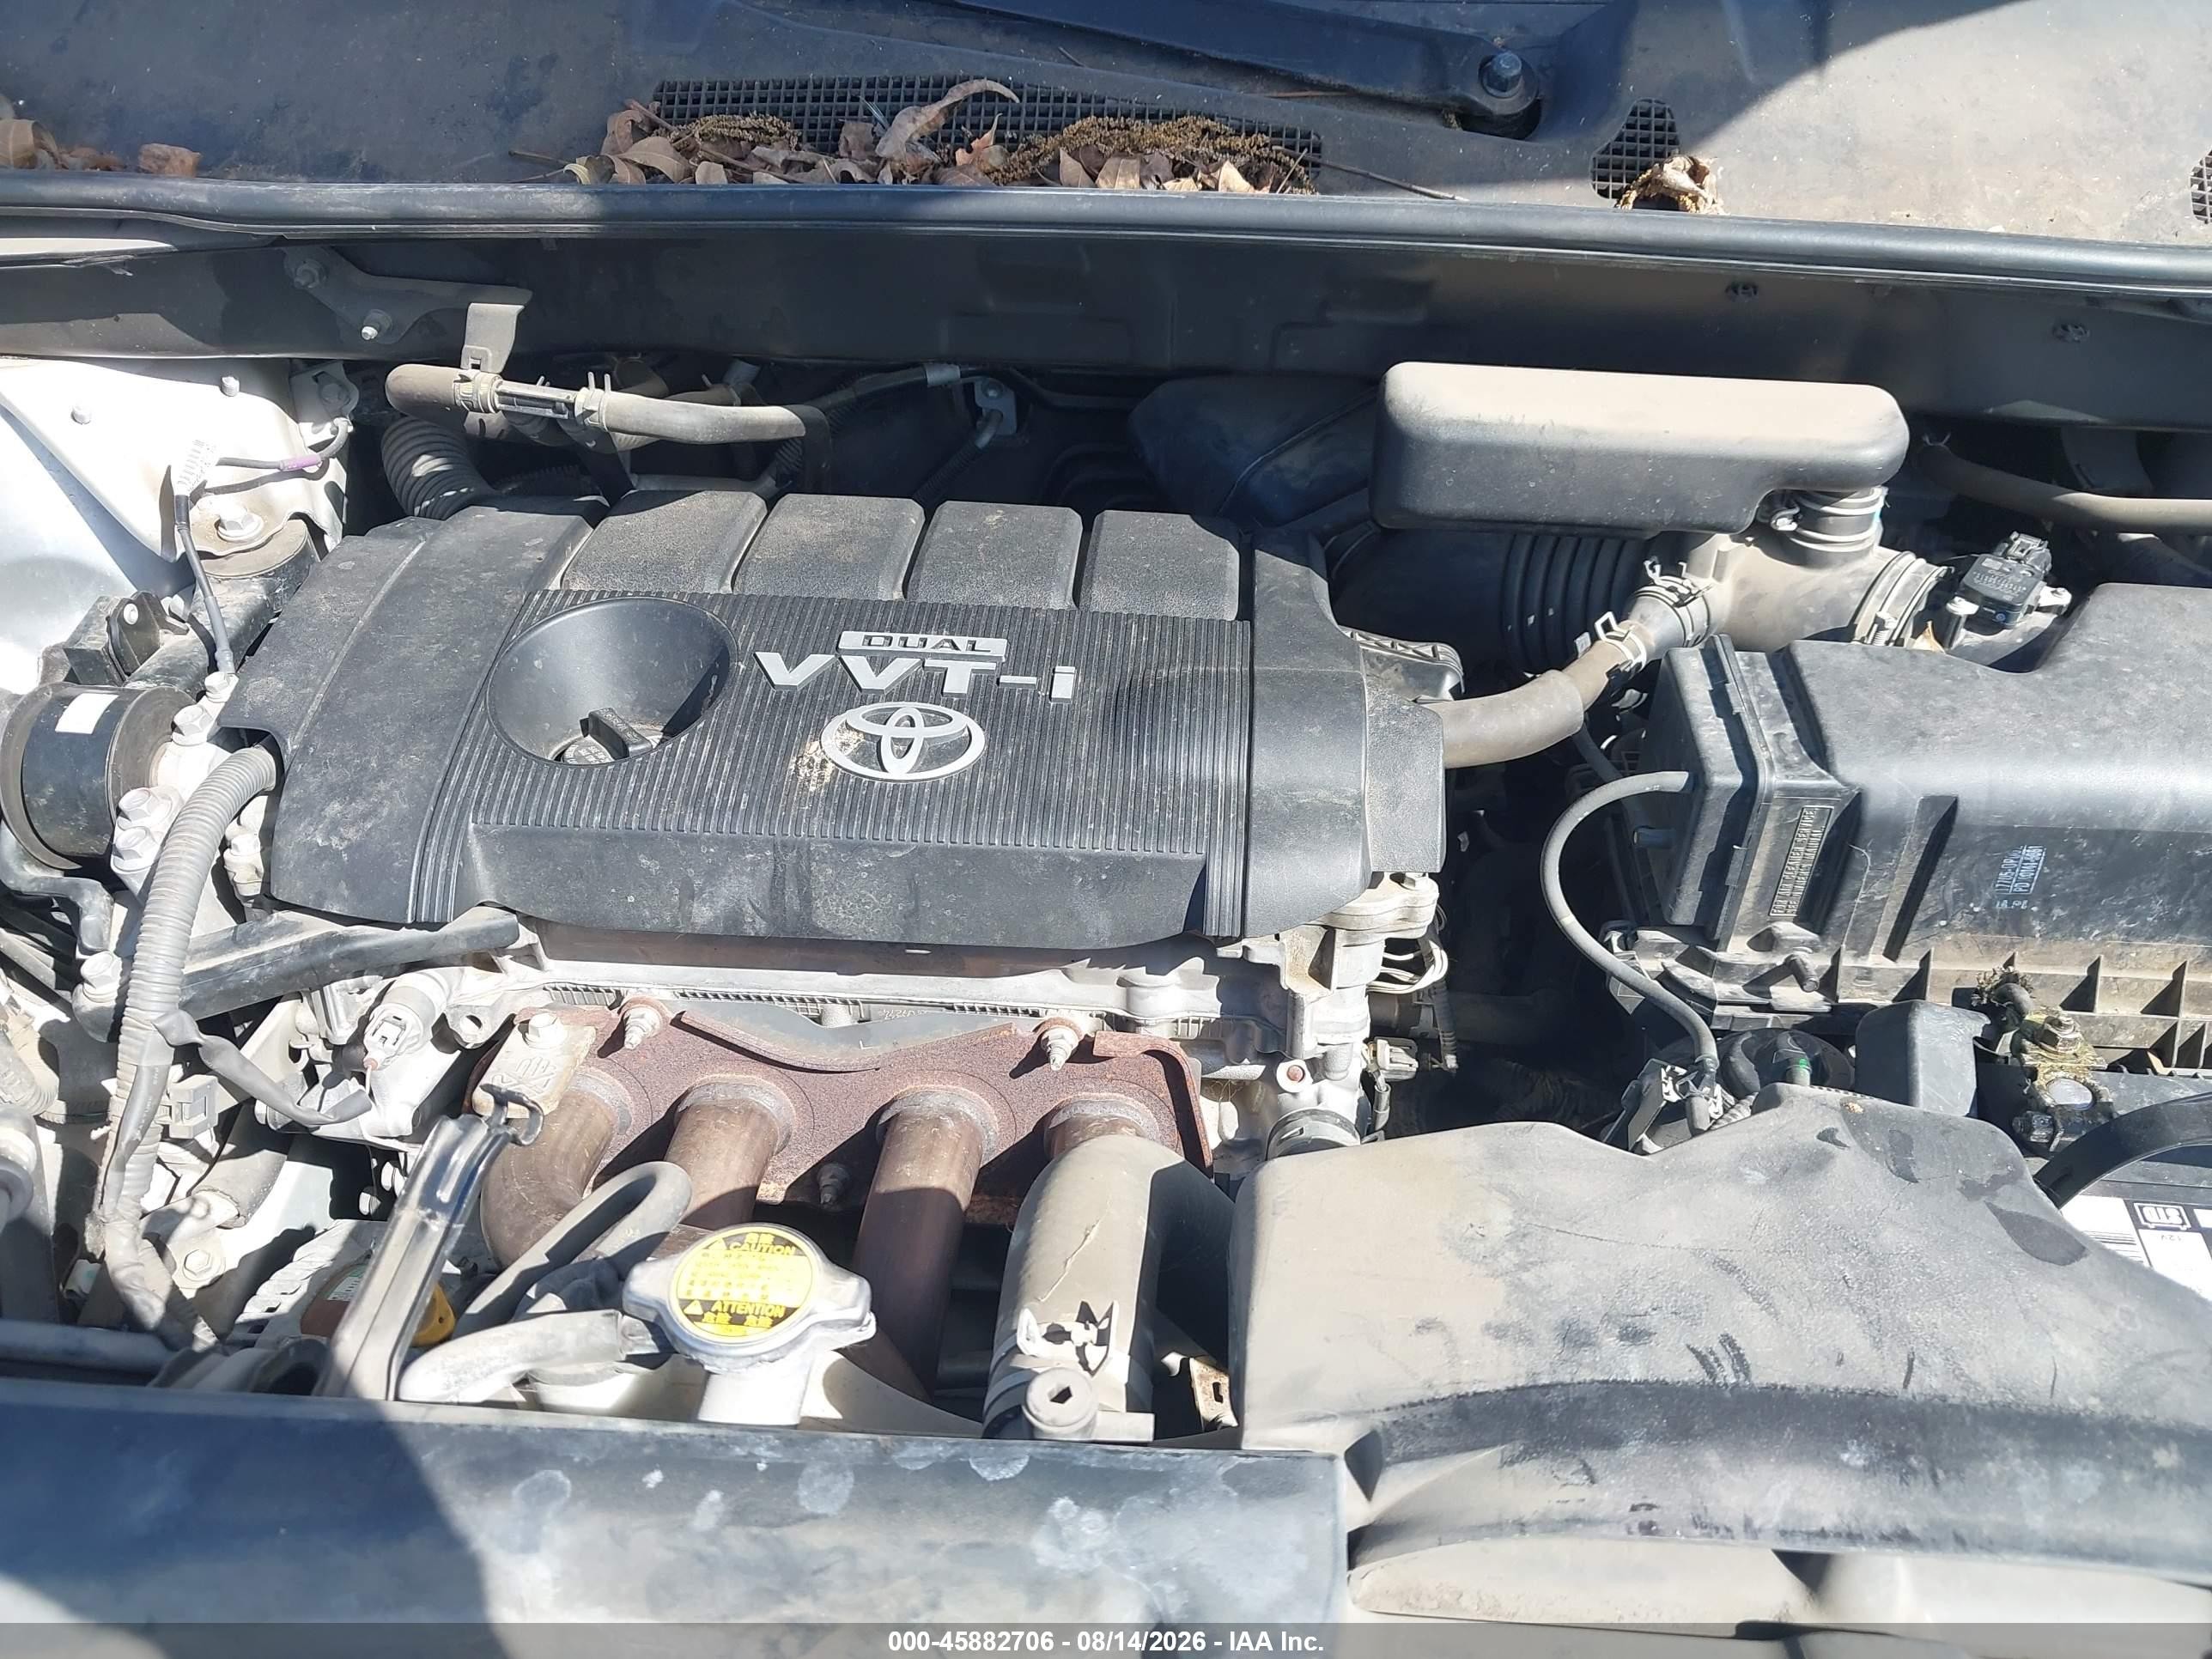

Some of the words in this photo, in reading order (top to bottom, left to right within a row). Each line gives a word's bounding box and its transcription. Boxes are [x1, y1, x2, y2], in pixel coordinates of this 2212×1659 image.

[862, 635, 992, 653] DUAL
[753, 651, 1076, 703] VVT-i
[1778, 884, 1793, 896] AIR
[1771, 898, 1787, 914] FOR
[730, 1242, 796, 1255] CAUTION
[712, 1300, 785, 1317] ATTENTION
